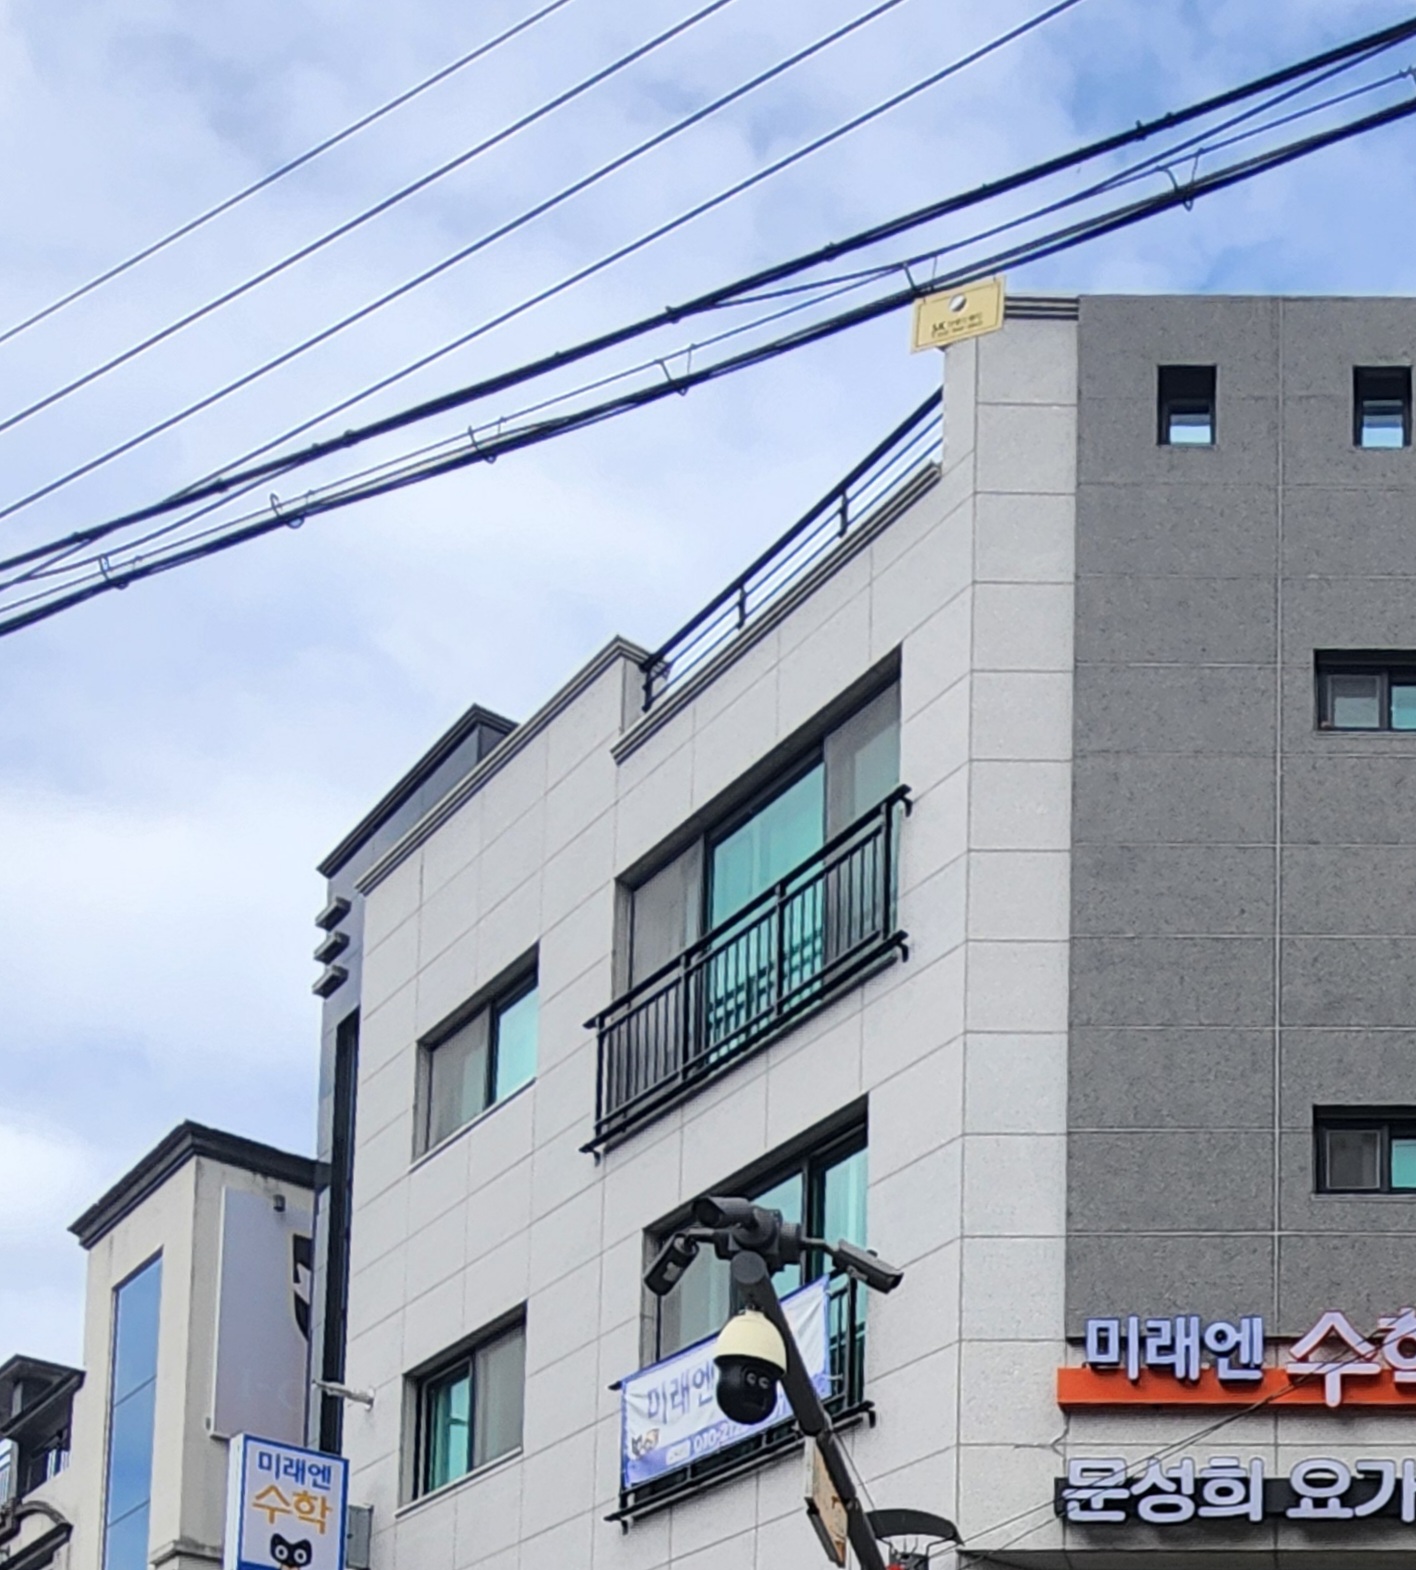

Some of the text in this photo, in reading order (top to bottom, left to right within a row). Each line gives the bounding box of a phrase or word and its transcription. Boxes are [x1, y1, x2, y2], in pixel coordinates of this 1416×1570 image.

[1085, 1314, 1264, 1382] 미래엔
[258, 1451, 332, 1491] 미래엔
[1063, 1458, 1265, 1522] 문성희
[252, 1484, 333, 1535] 수학
